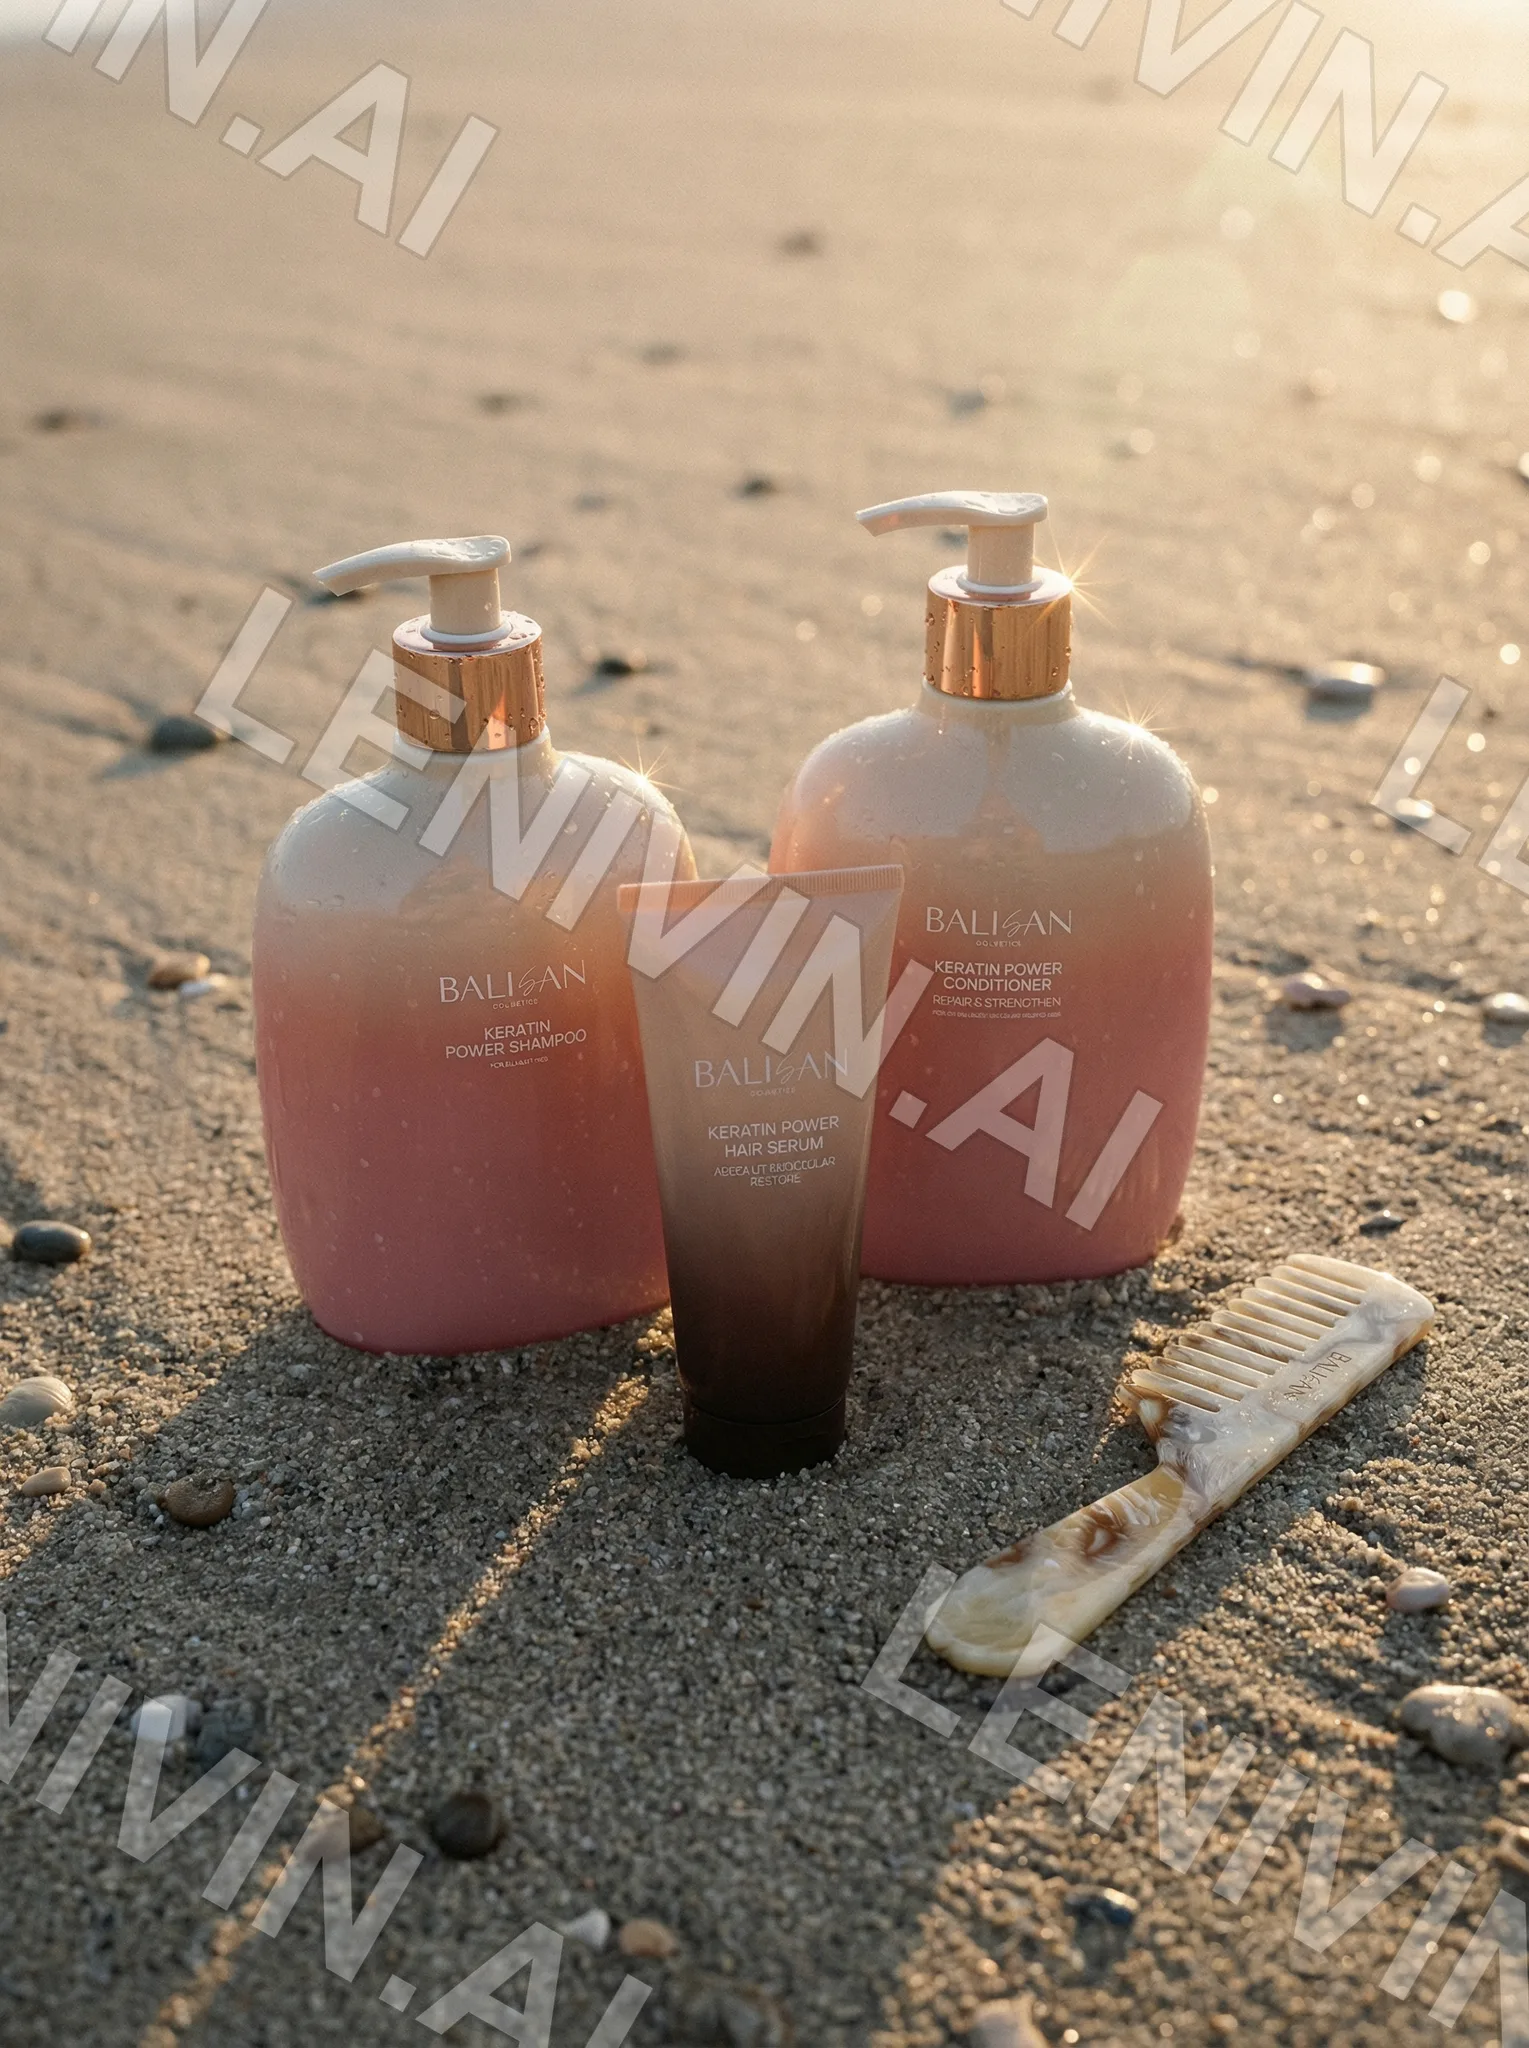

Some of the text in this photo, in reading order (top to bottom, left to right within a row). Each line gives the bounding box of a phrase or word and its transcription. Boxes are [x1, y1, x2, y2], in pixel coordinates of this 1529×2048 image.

[926, 906, 1072, 938] BALISAN
[934, 960, 1062, 976] KERATIN POWER
[439, 959, 586, 1003] BALISAN
[943, 977, 1051, 992] CONDITIONER
[932, 994, 972, 1008] REPAIR
[484, 1020, 550, 1041] KERATIN
[445, 1028, 587, 1059] POWER SHAMPOO
[694, 1047, 849, 1088] BALISAN
[708, 1115, 839, 1140] KERATIN POWER
[725, 1136, 824, 1158] HAIR SERUM
